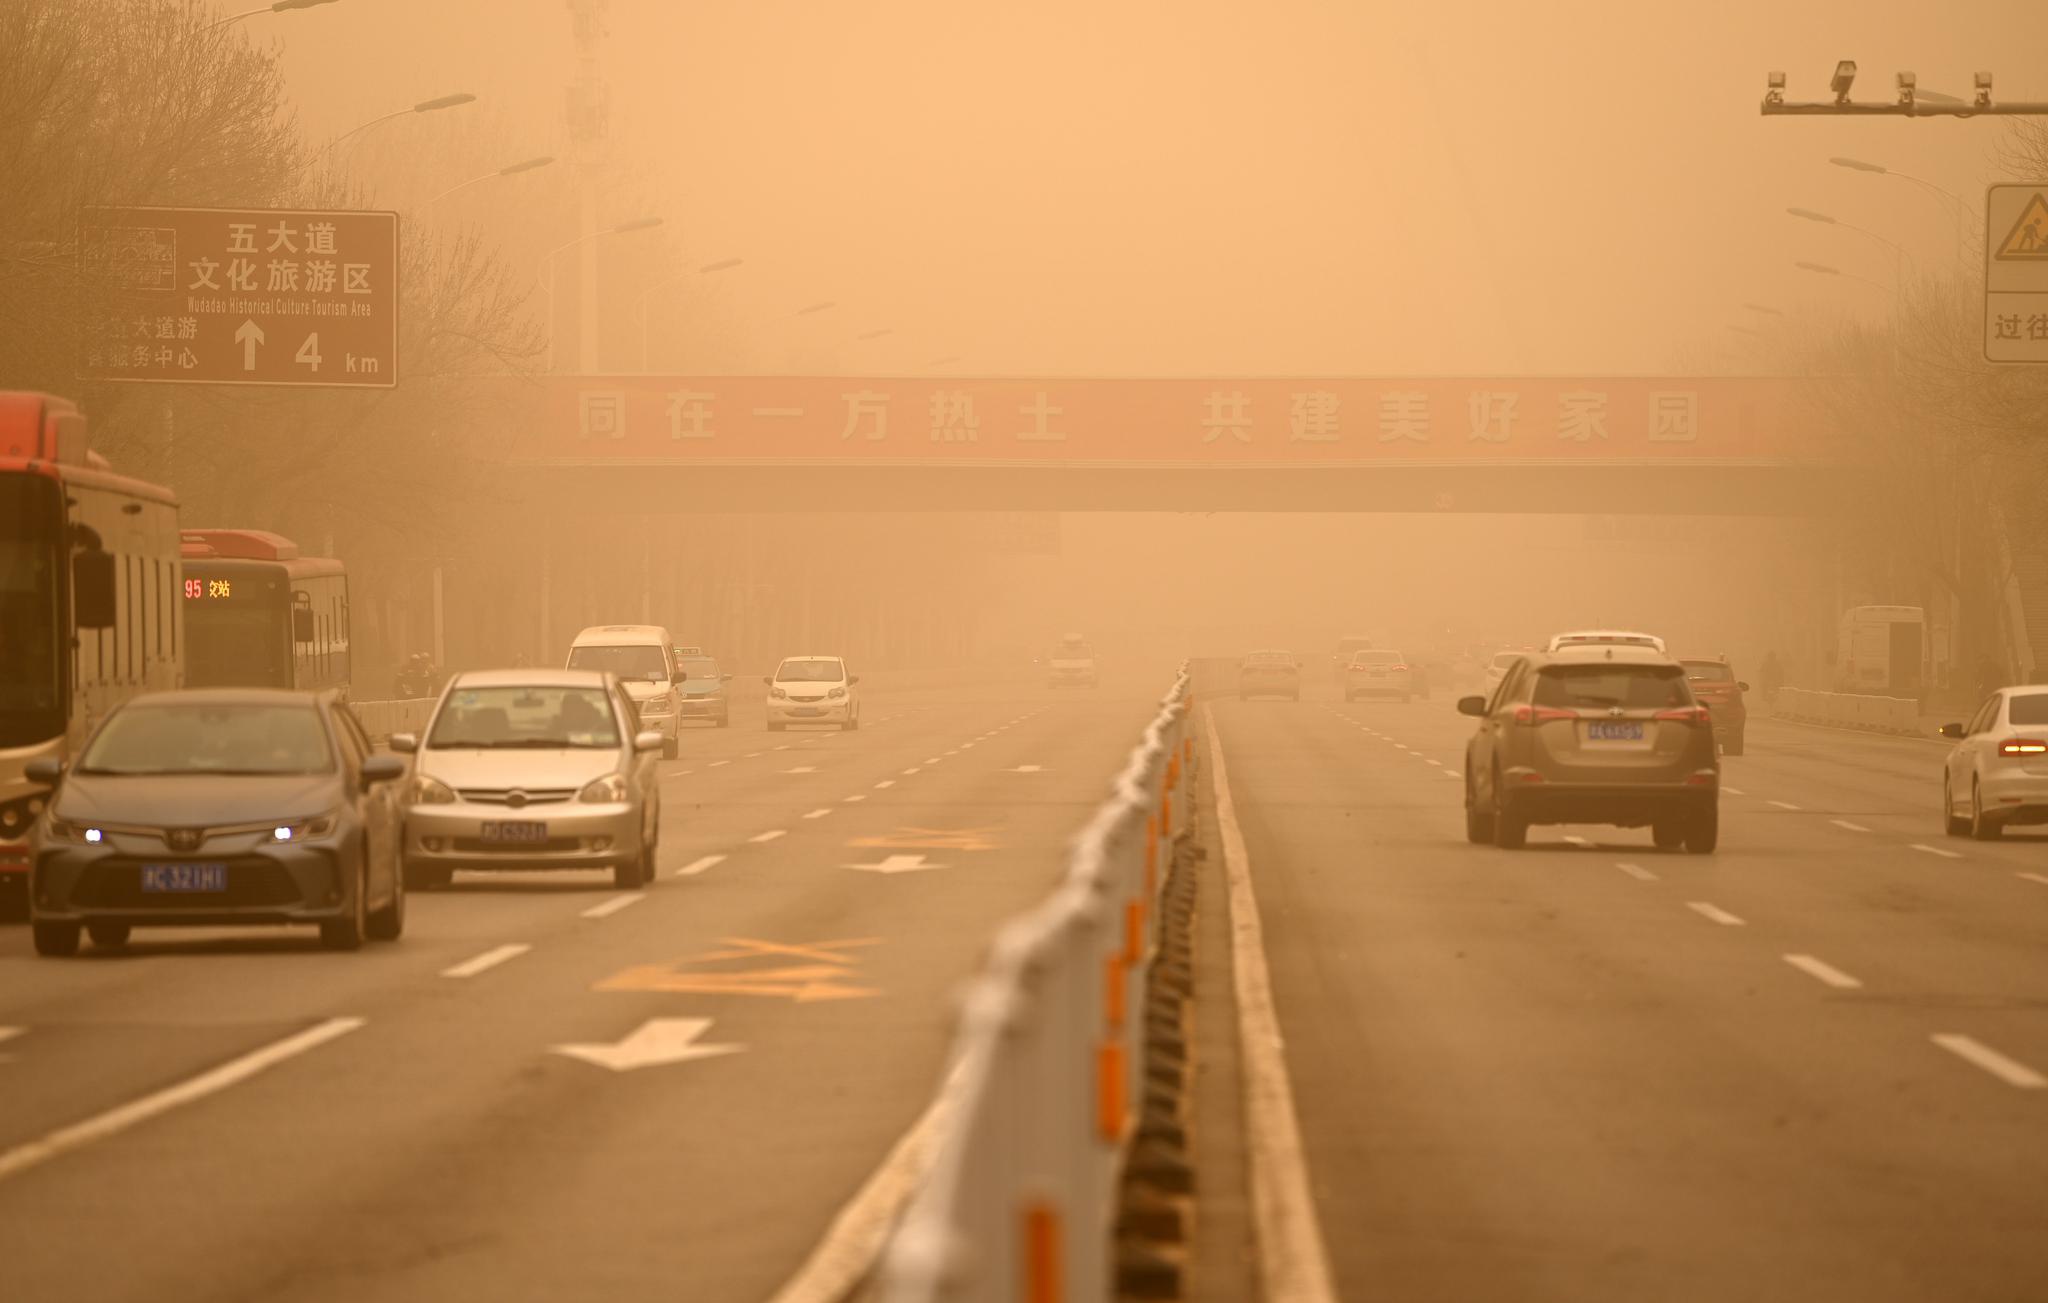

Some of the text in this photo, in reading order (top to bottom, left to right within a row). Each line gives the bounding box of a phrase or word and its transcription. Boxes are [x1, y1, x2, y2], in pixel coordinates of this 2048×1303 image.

[226, 220, 339, 255] 五大道
[188, 257, 373, 294] 文化旅游区
[187, 296, 372, 317] Wudadao Historical Culture Tourism Area
[295, 332, 379, 373] 4 km
[578, 389, 1699, 444] 同在一方热土 共建美好家园
